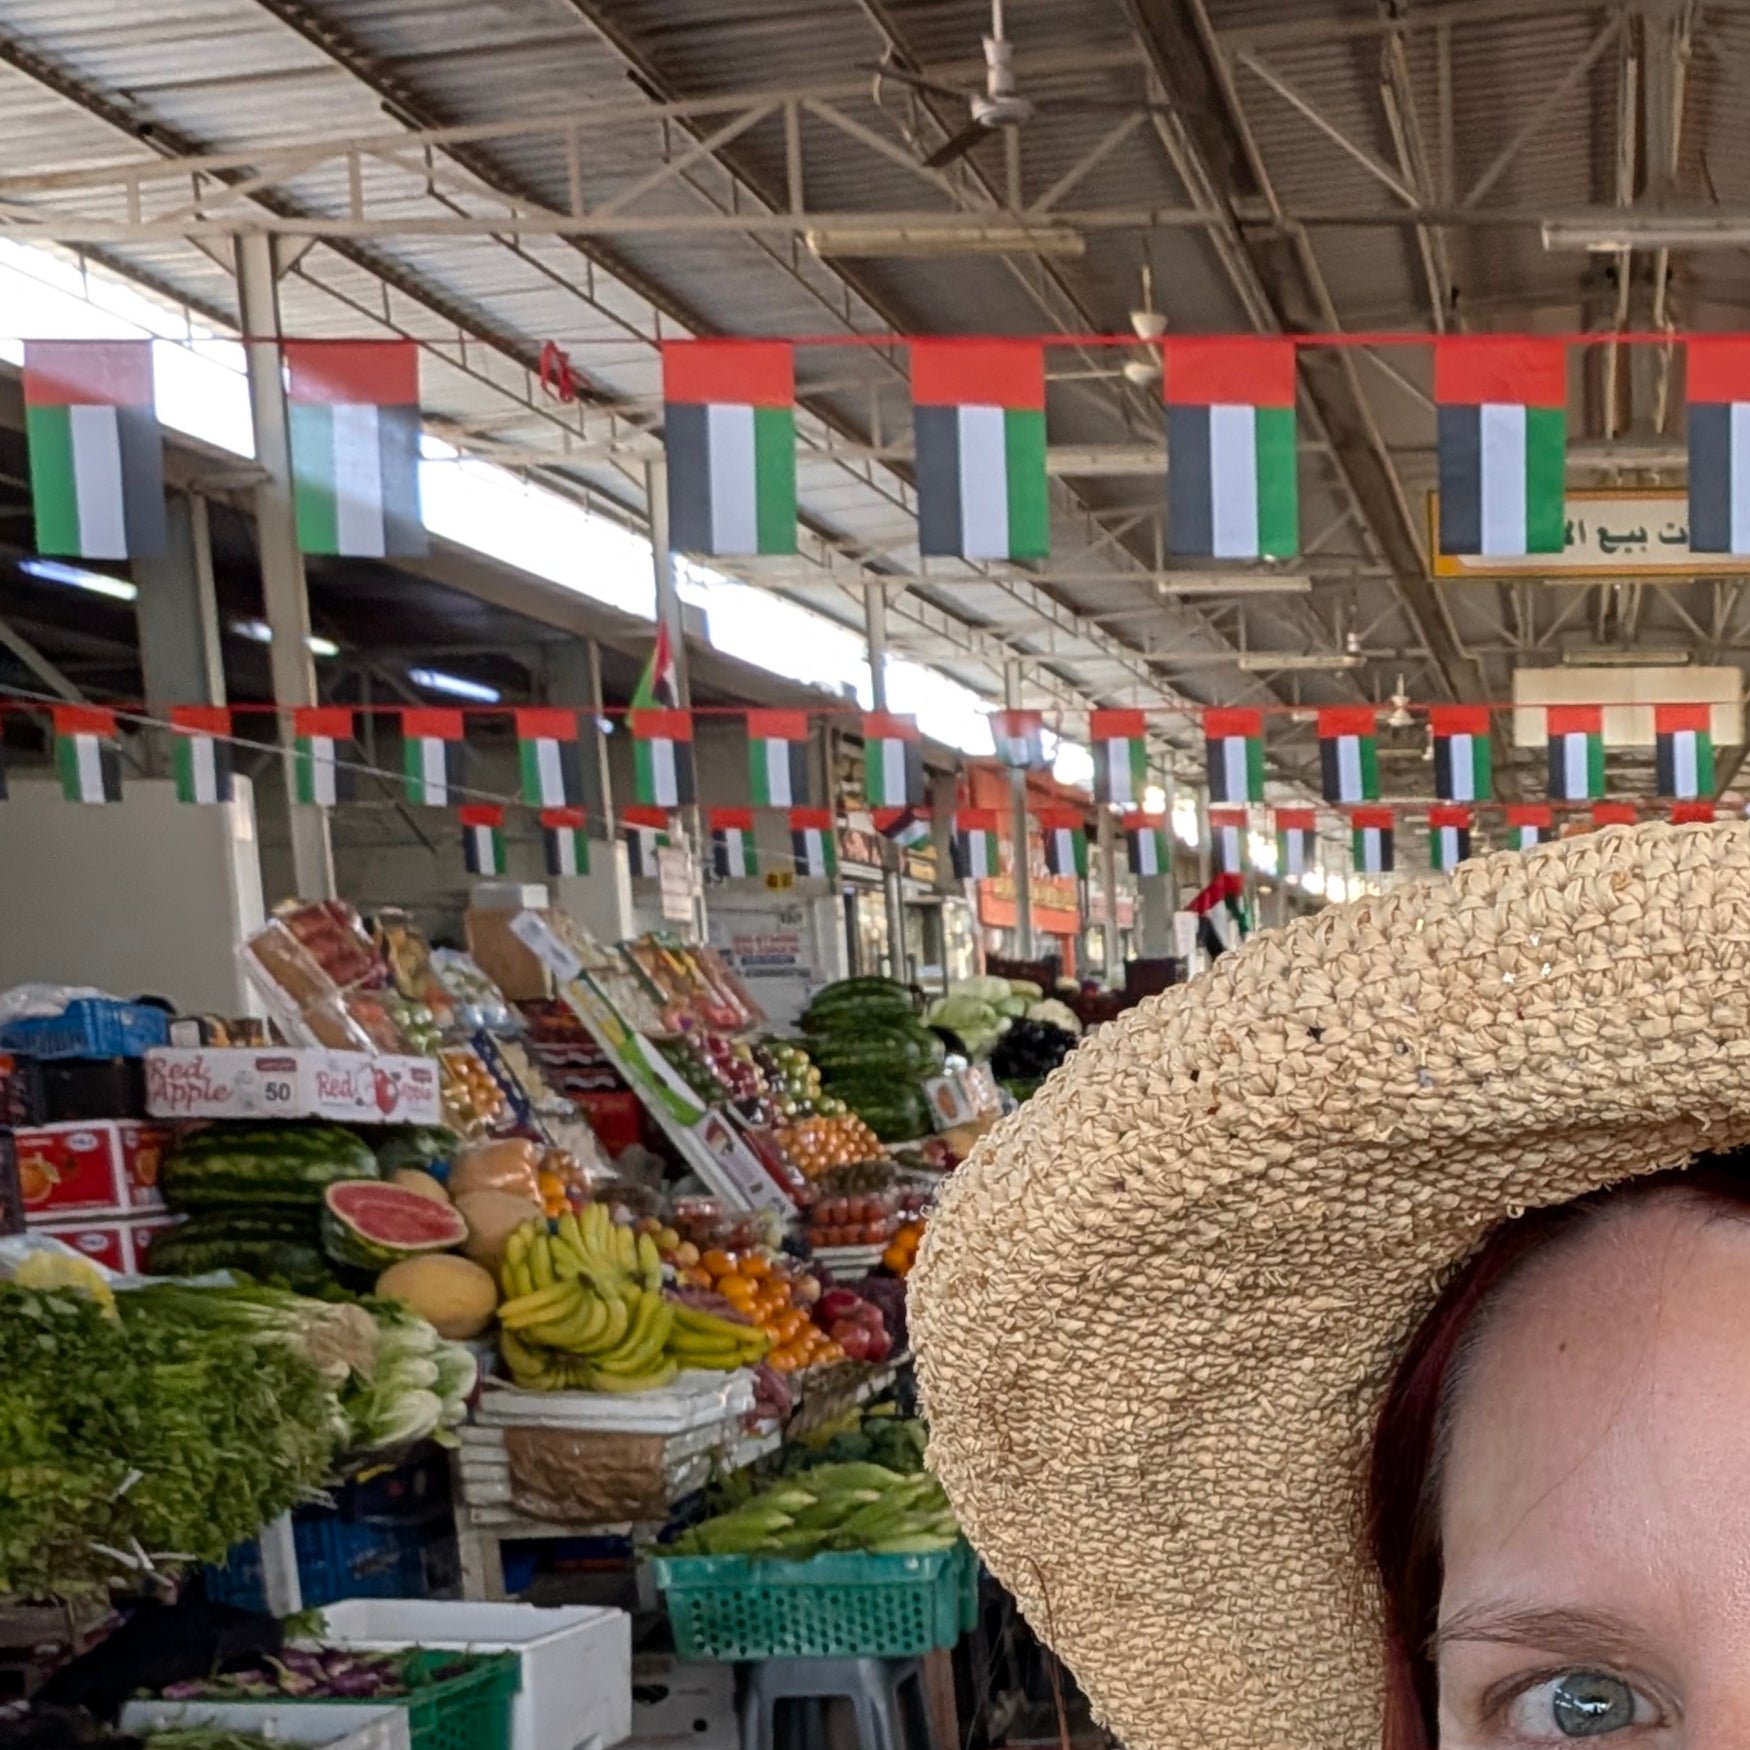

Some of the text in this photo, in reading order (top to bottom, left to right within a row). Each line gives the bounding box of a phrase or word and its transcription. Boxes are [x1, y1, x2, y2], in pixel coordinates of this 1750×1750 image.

[1597, 525, 1648, 554] بيع
[150, 1055, 206, 1080] Red
[151, 1077, 233, 1112] Apple
[264, 1081, 292, 1102] 50
[315, 1070, 356, 1099] Red
